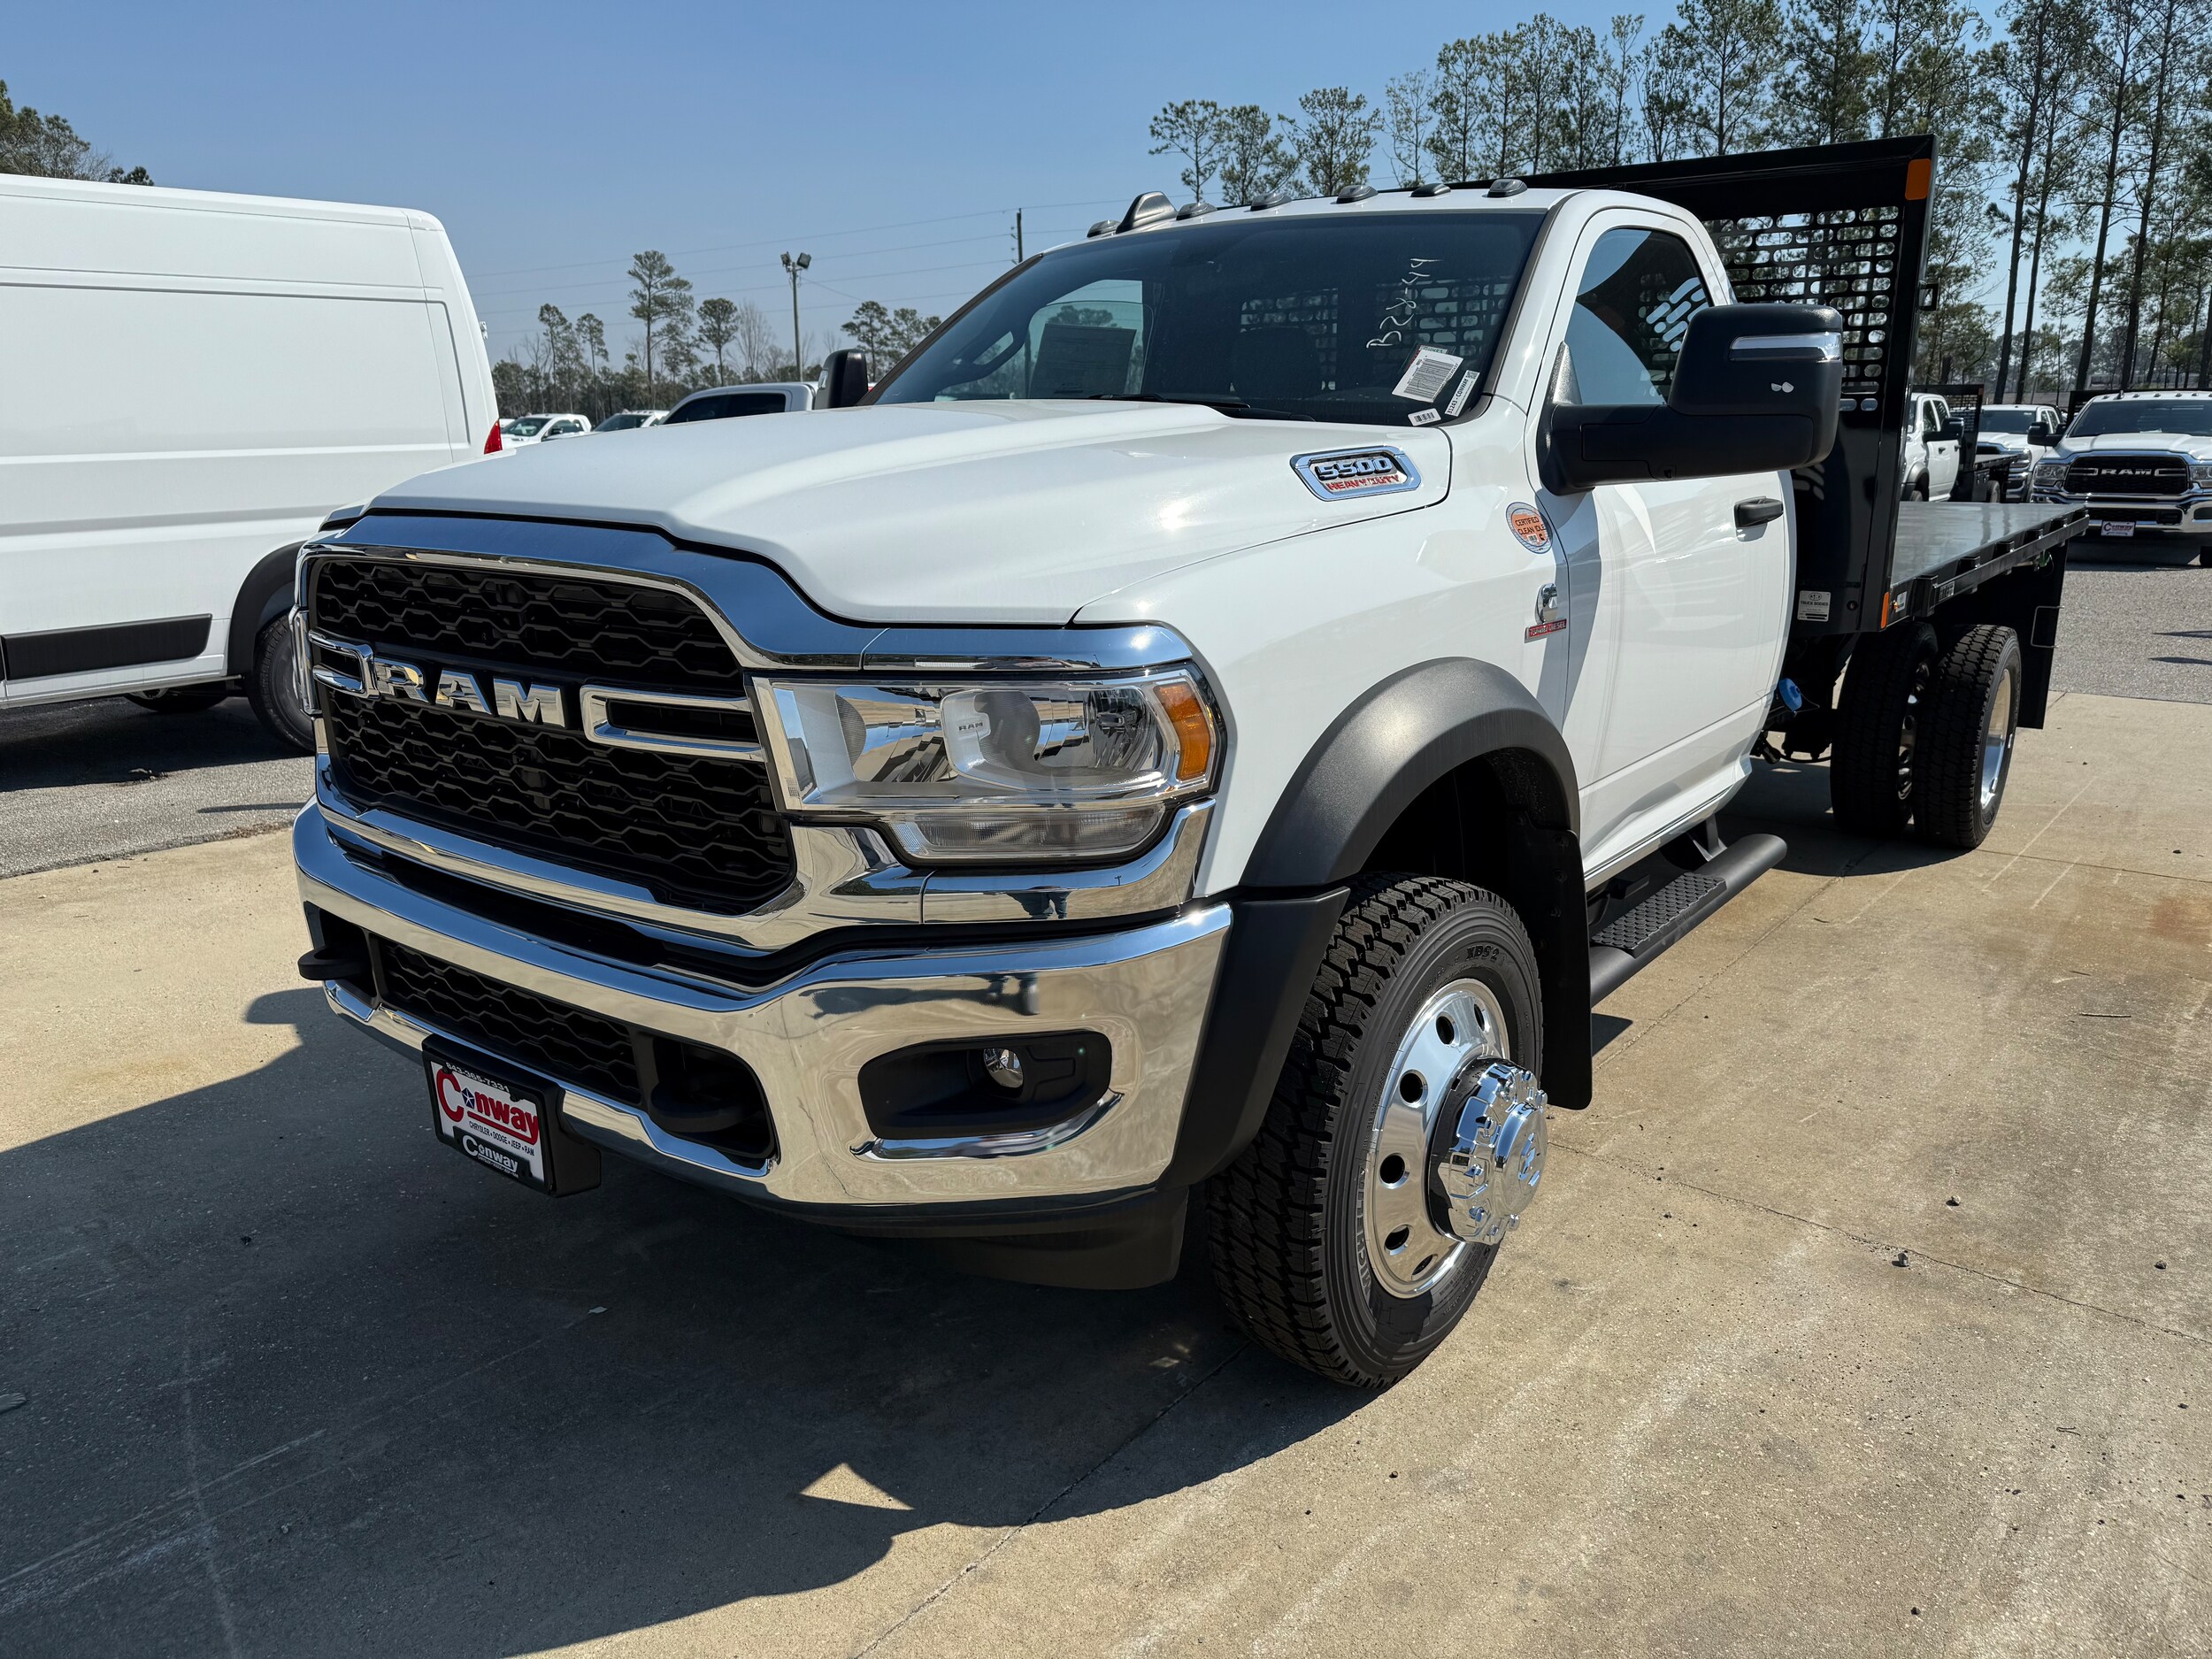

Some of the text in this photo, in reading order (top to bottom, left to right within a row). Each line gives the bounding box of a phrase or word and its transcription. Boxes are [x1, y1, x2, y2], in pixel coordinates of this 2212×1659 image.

[1455, 378, 1469, 397] CONWAY
[1316, 457, 1394, 480] 5500
[1325, 474, 1399, 490] HEAVY DUTY
[1515, 517, 1539, 526] CERTIFIED
[374, 657, 566, 728] RAM
[958, 722, 983, 731] RAM
[436, 1068, 540, 1145] Conway
[469, 1120, 535, 1156] CHRYSLER DODGE JEEP RAM
[462, 1134, 518, 1172] Conway
